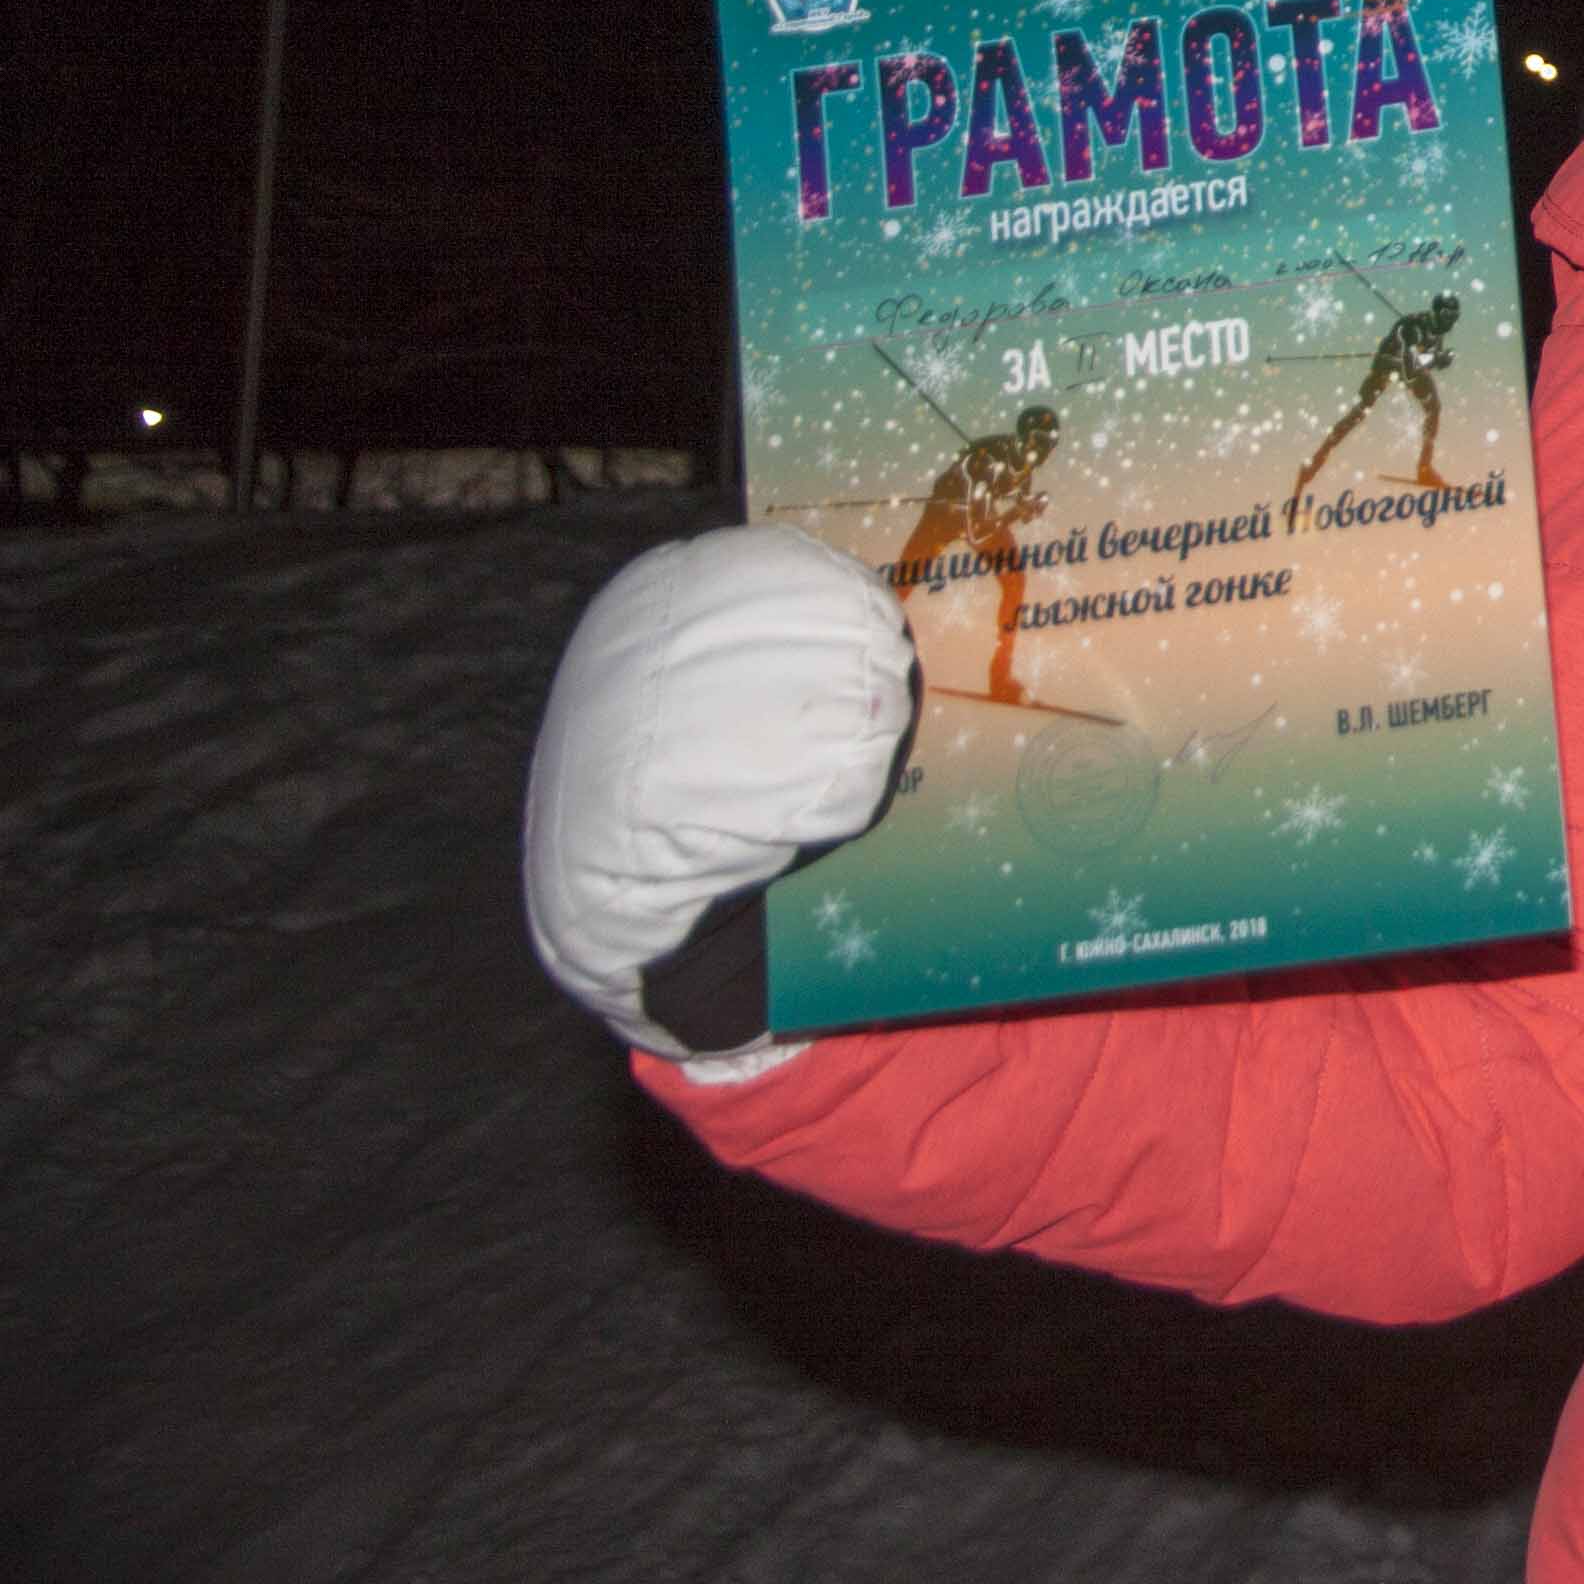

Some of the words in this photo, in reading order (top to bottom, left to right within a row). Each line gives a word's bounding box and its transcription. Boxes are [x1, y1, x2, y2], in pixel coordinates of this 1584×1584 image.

[989, 176, 1249, 244] награждается
[1001, 340, 1050, 394] ЗА
[1124, 317, 1250, 378] МЕСТО
[1097, 502, 1271, 561] вечерней
[1280, 471, 1507, 536] Новогодней
[1003, 573, 1176, 633] лыжной
[1185, 564, 1294, 612] гонке
[1337, 707, 1381, 735] В.Л.
[1388, 689, 1492, 730] ШЕМБЕРГ
